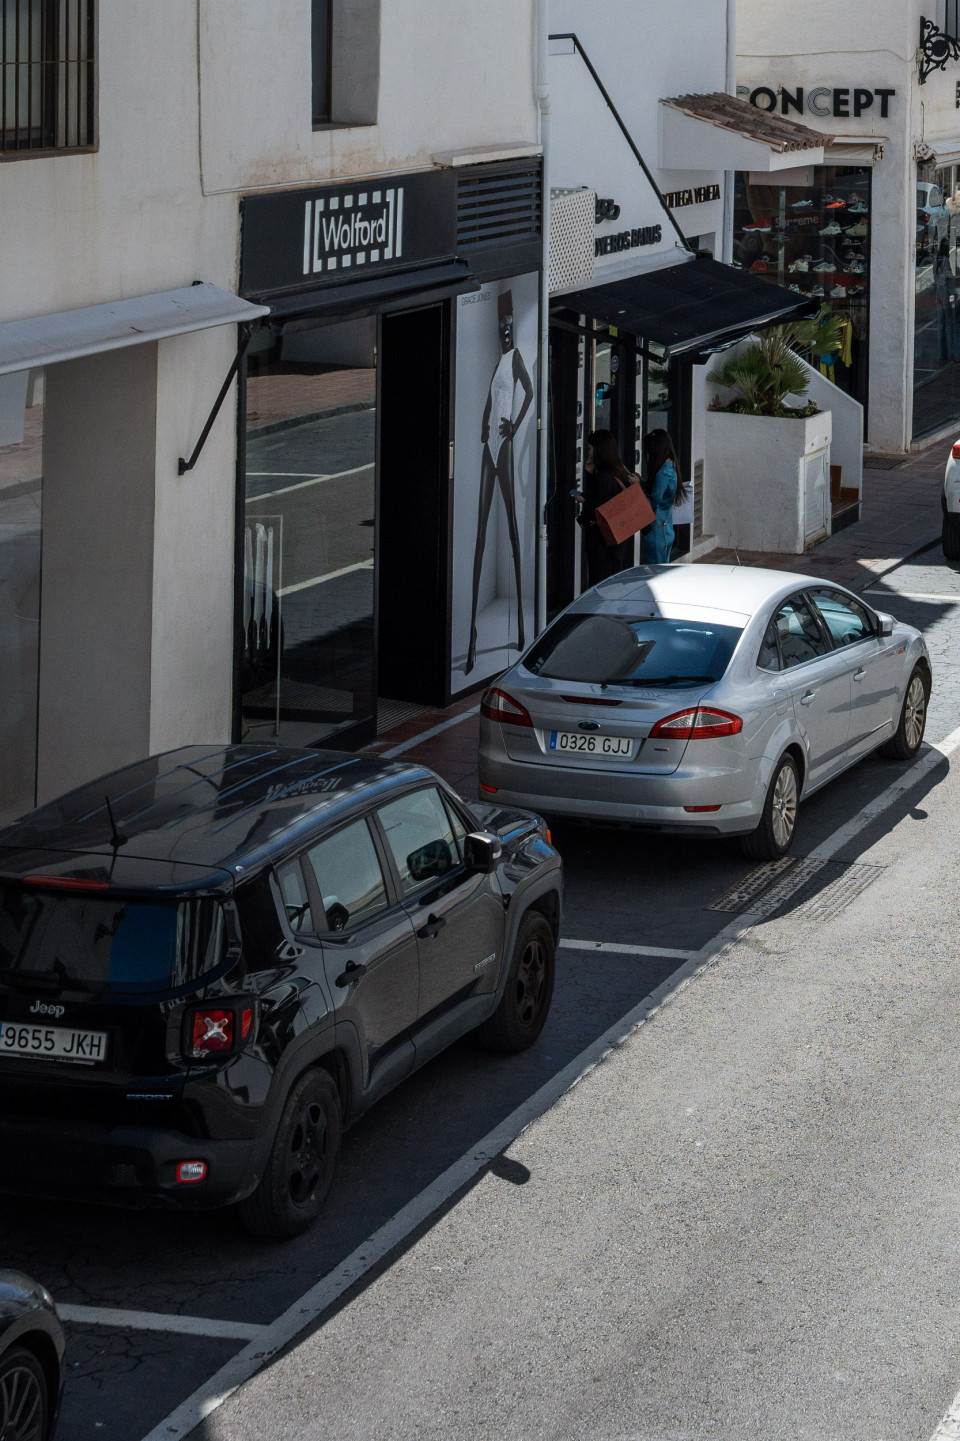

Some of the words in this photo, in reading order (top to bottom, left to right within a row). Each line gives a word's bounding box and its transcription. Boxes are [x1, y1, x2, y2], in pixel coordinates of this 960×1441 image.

[322, 208, 387, 252] Wolford
[560, 734, 596, 752] 0326
[602, 738, 631, 755] GJJ
[30, 1000, 65, 1018] Jeep
[4, 1026, 55, 1051] 9655
[63, 1032, 102, 1057] JKH
